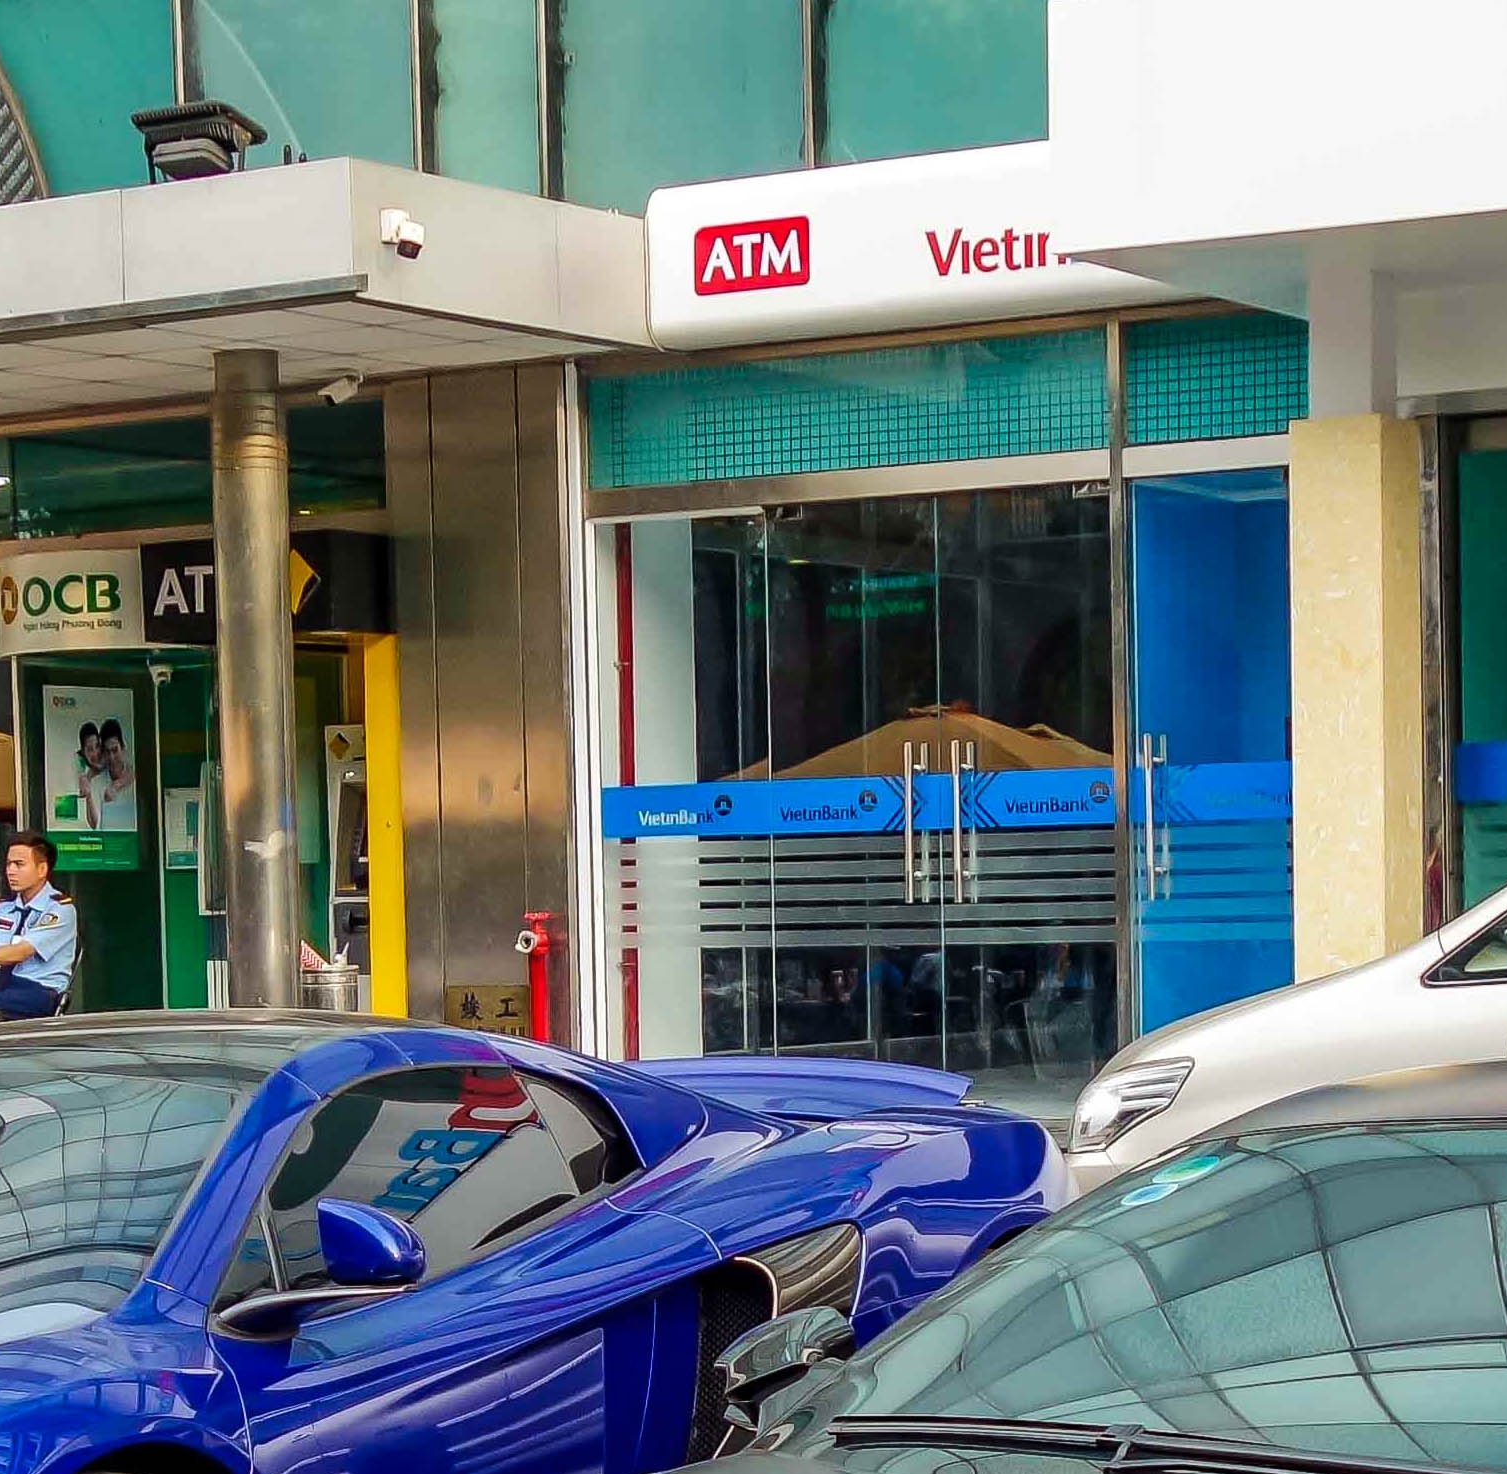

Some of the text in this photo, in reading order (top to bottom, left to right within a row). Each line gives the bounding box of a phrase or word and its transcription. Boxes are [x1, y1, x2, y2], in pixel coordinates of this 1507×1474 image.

[701, 228, 802, 283] ATM
[22, 574, 121, 617] OCB
[153, 565, 213, 616] AT
[638, 808, 714, 827] VietinBank
[780, 804, 859, 822] VietinBank
[1005, 796, 1090, 815] VietinBank
